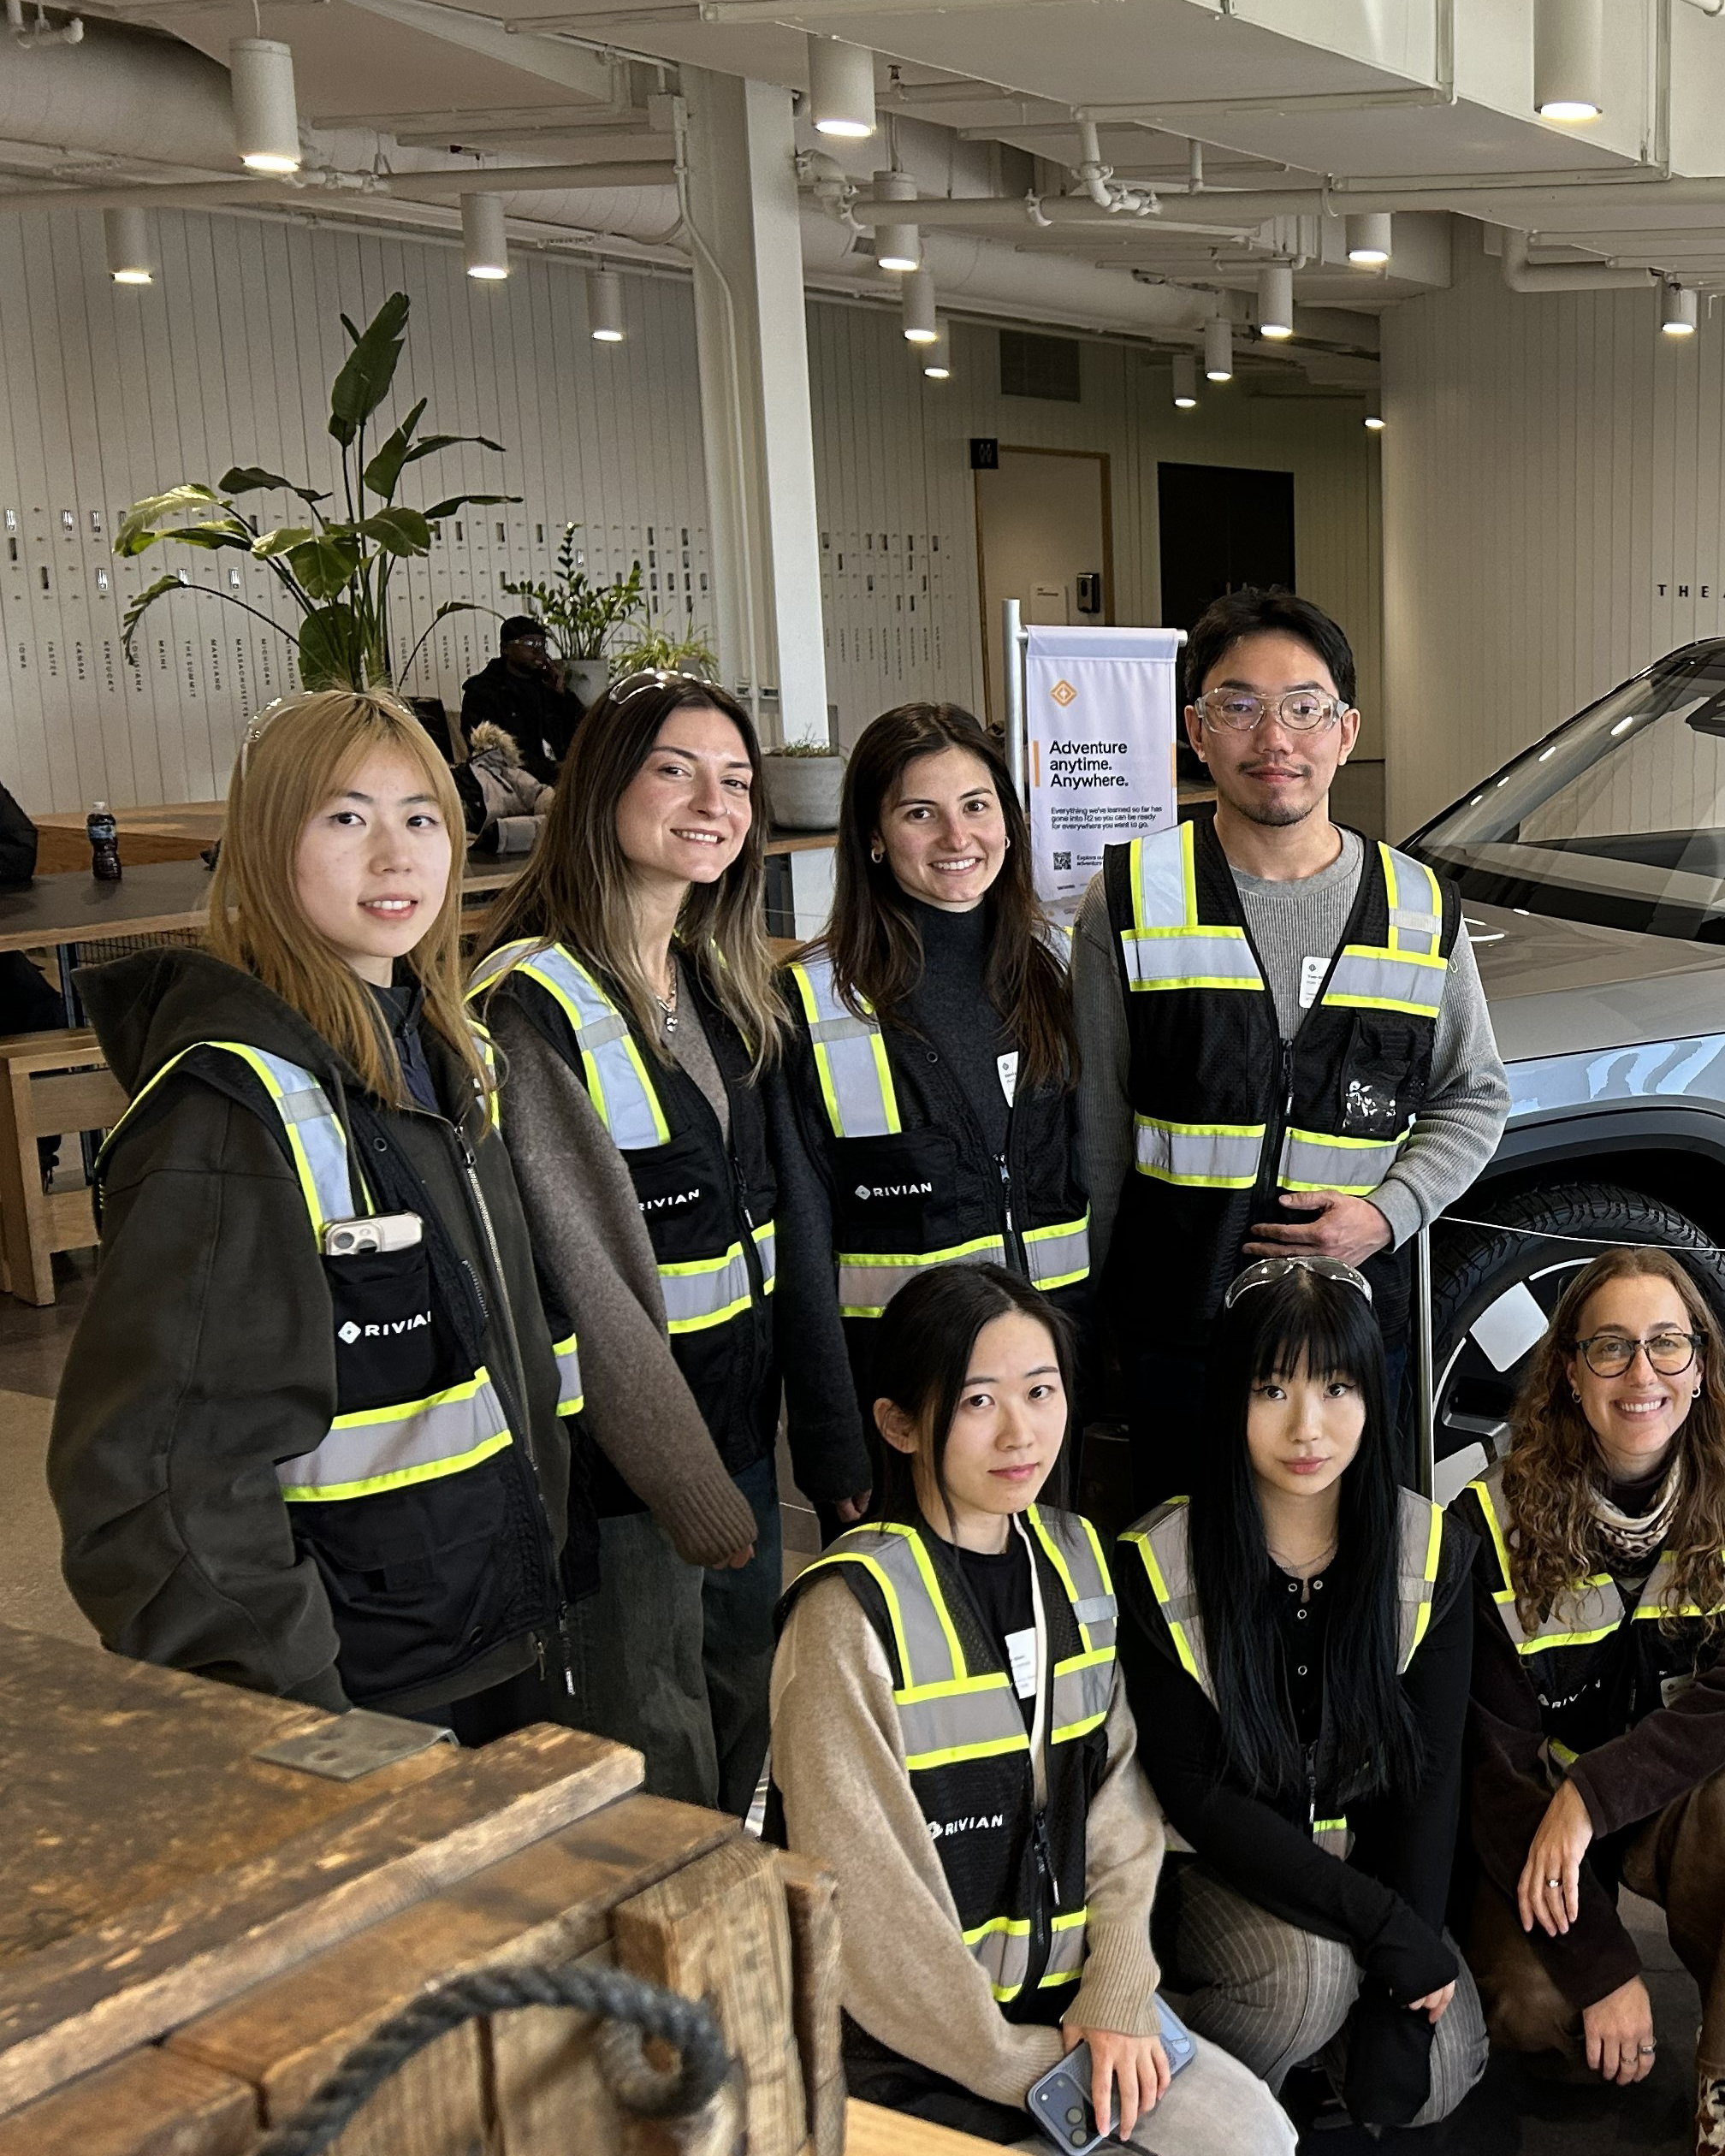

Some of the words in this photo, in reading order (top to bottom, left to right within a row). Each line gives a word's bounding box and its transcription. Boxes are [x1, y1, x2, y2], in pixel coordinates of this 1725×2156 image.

[1657, 584, 1710, 598] THE
[75, 642, 86, 680] KANSAS
[104, 641, 115, 692] KENTUCKY
[158, 640, 167, 670] MAINE
[210, 638, 222, 690] MARYLAND
[261, 638, 270, 685] MICHIGAN
[285, 637, 295, 690] MINNESOTA
[187, 661, 197, 697] SUMMIT
[236, 638, 249, 717] MASSACHUSETTS
[1049, 740, 1128, 755] Adventure
[1049, 757, 1112, 774] anytime.
[1050, 773, 1129, 791] Anywhere.
[873, 1182, 933, 1197] RIVIAN
[945, 1814, 1004, 1836] RIVIAN
